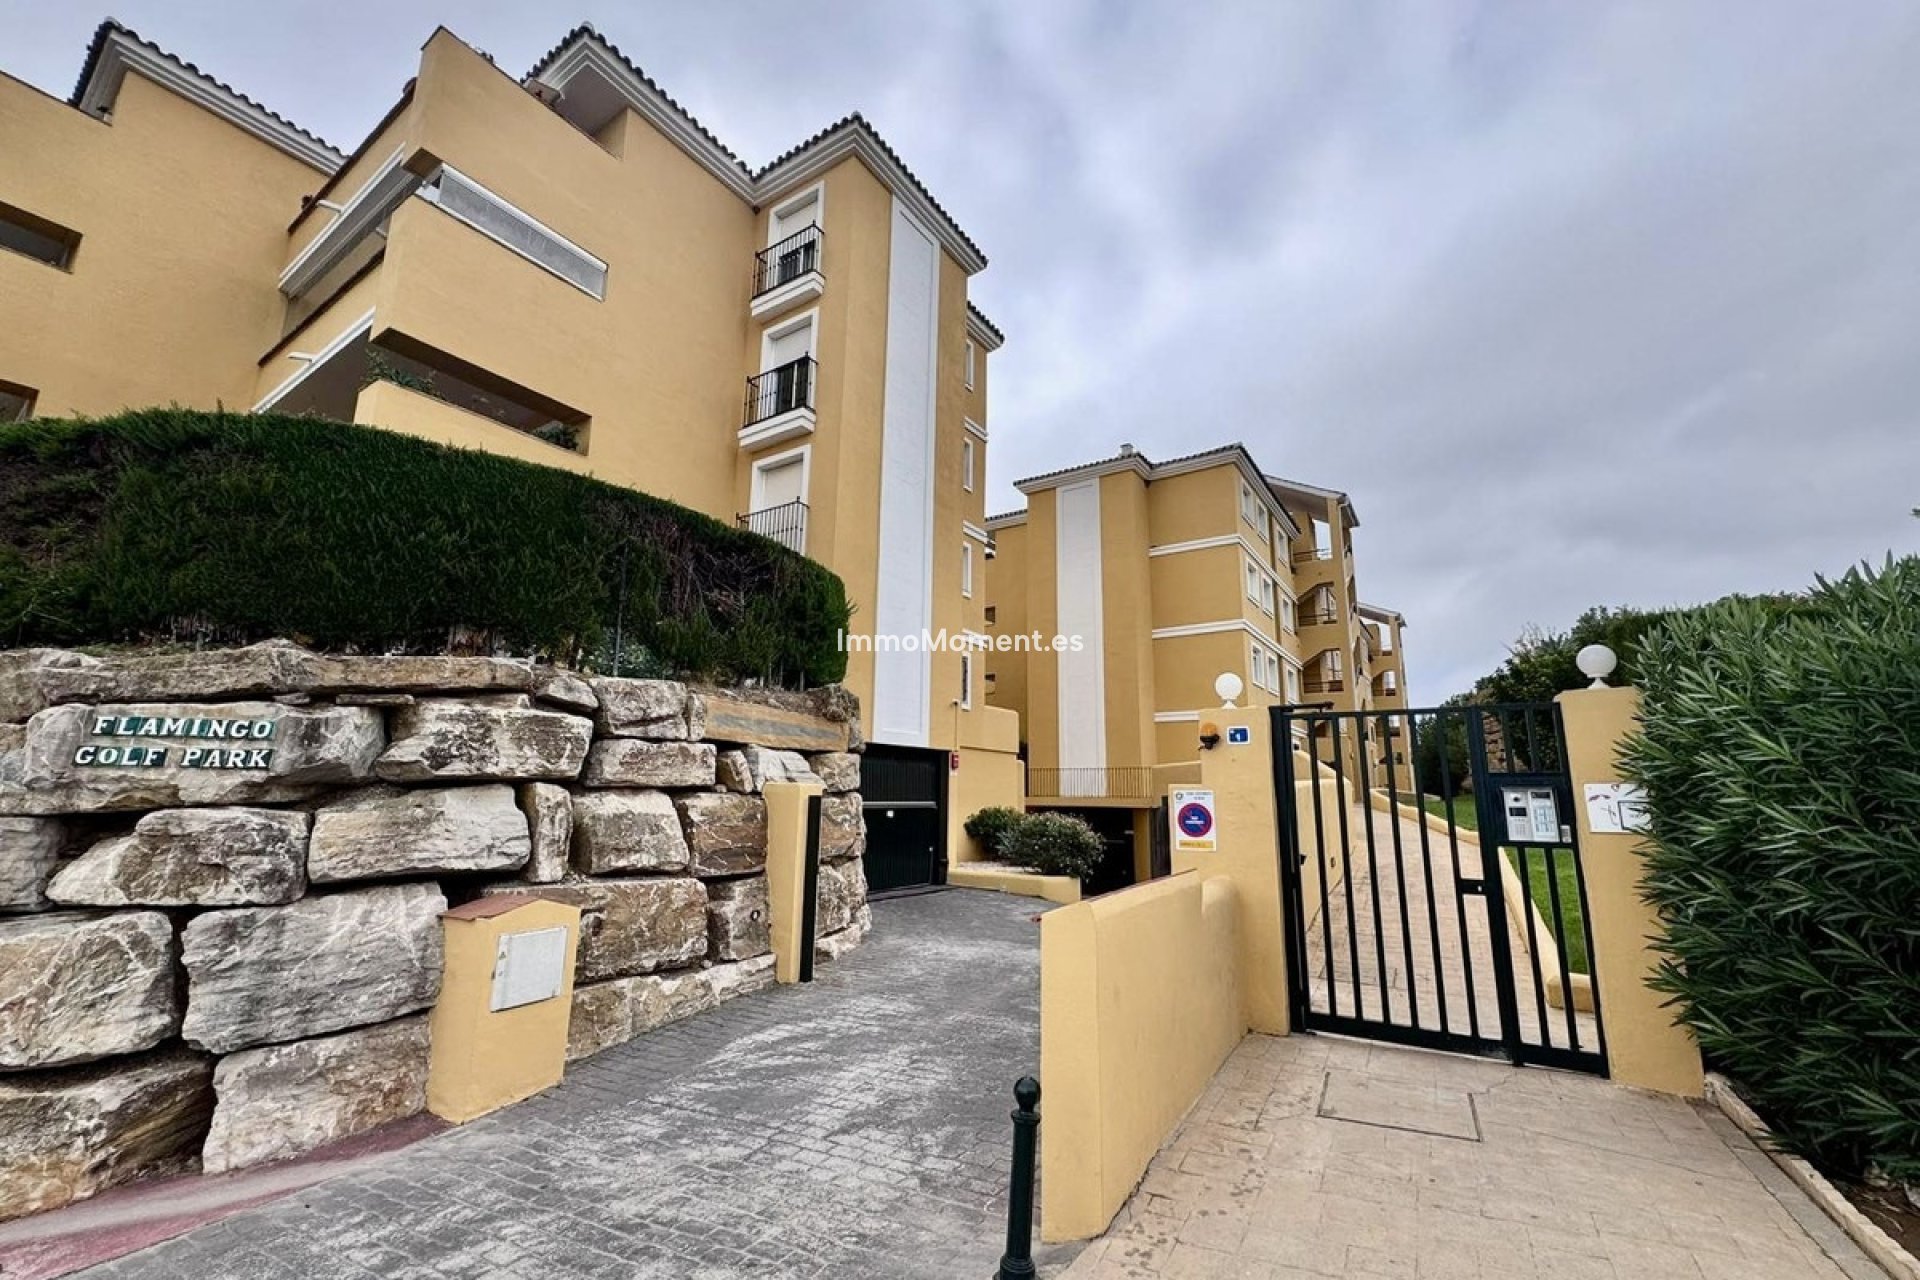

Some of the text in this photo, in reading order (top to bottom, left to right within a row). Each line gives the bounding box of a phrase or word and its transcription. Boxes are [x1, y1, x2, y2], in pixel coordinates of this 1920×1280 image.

[92, 716, 273, 739] FLAMINGO
[74, 746, 271, 768] GOLF PARK
